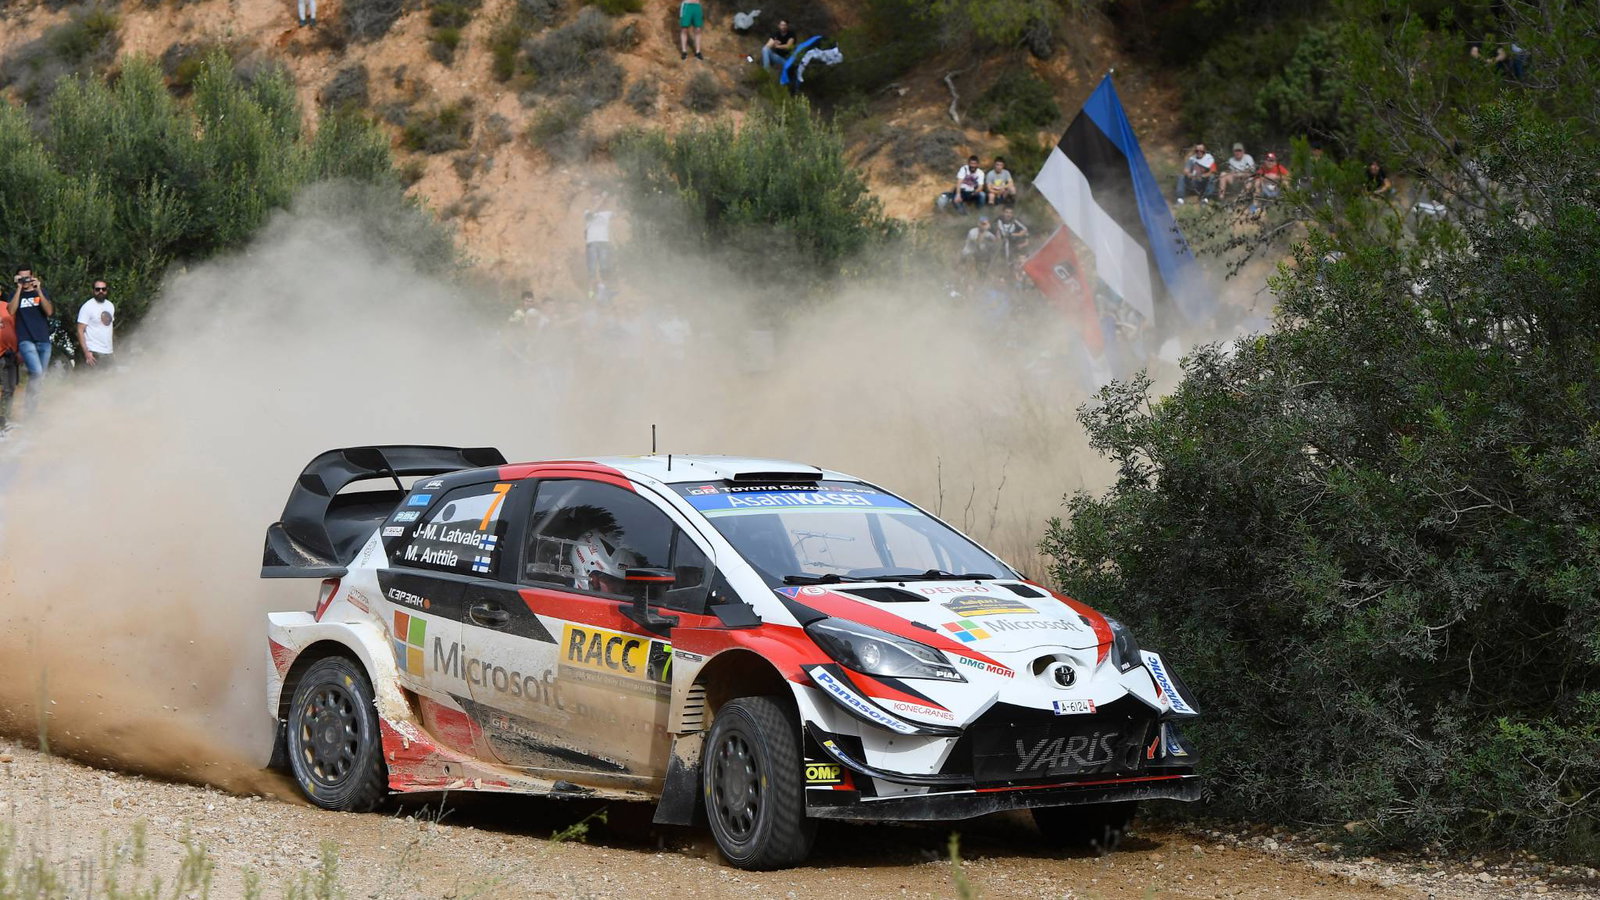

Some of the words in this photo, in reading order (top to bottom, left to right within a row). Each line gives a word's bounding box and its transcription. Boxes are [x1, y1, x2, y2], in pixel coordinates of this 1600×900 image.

[479, 483, 512, 530] 7
[412, 523, 437, 540] J-M.
[440, 526, 481, 546] Latvala
[404, 545, 418, 561] M.
[420, 547, 458, 567] Anttila
[920, 586, 990, 595] DENSO
[983, 619, 1083, 632] Microsoft
[568, 628, 640, 673] RACC
[433, 636, 565, 710] Microsoft
[936, 671, 960, 680] PIAA
[959, 657, 985, 670] DMG
[985, 666, 1016, 679] MORI
[1148, 656, 1190, 712] Panasonic
[818, 672, 910, 731] Panasonic
[893, 702, 955, 721] KONECRANES
[1061, 701, 1089, 713] A-6124
[805, 766, 841, 780] OMP
